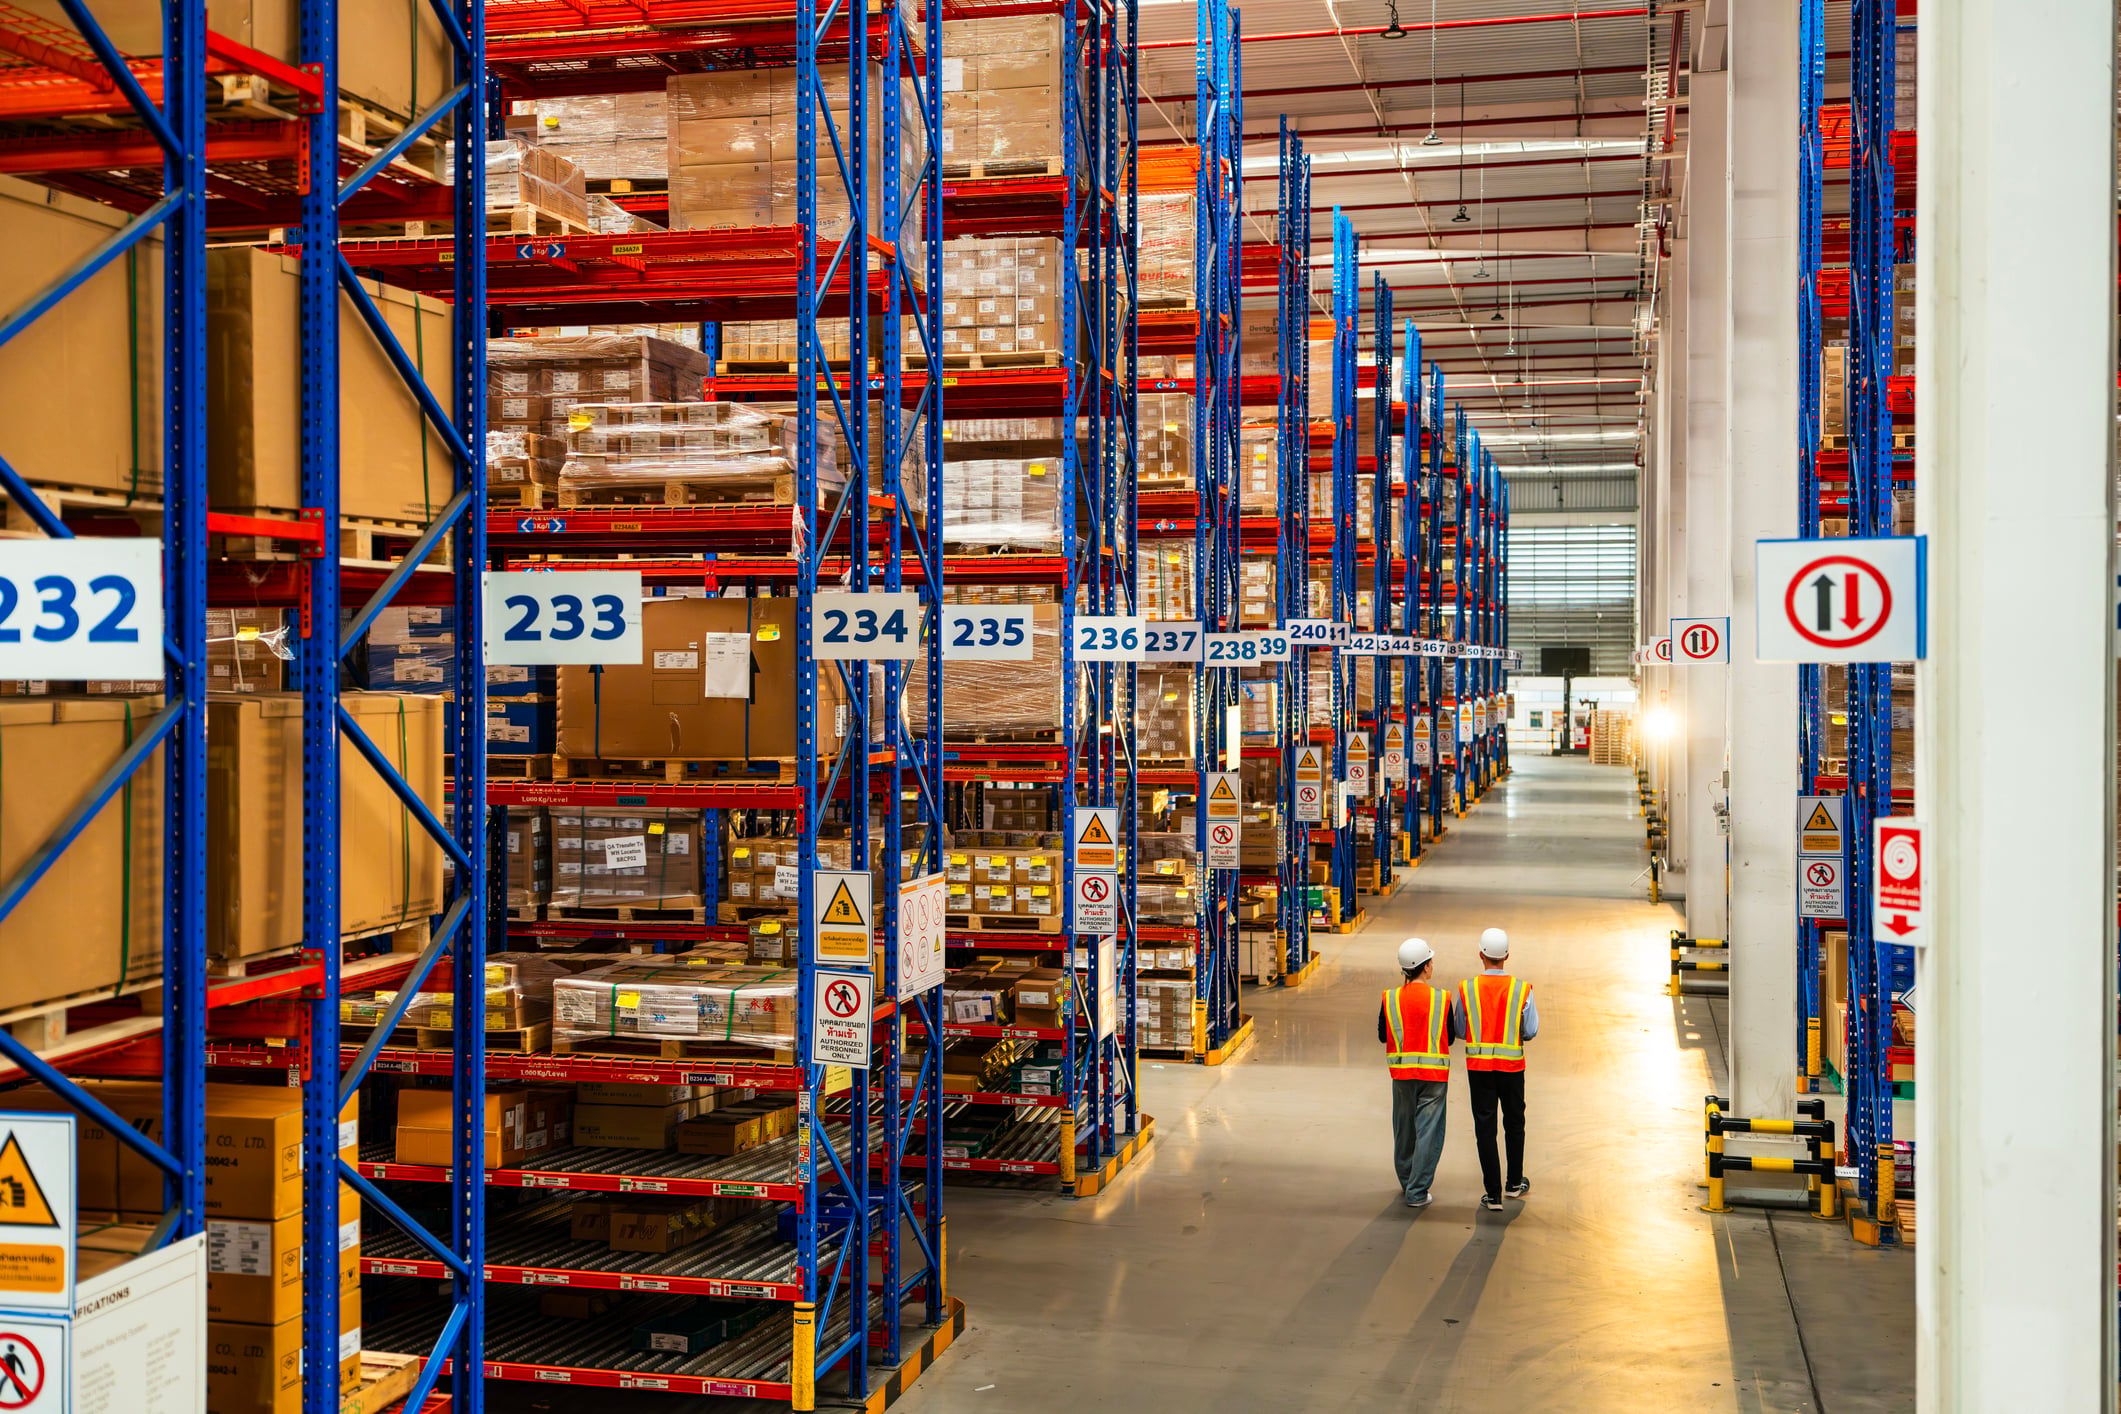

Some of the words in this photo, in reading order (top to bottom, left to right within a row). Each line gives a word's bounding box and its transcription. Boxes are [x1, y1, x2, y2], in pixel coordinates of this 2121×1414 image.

[504, 594, 627, 642] 233
[822, 609, 908, 644] 234
[952, 618, 1025, 647] 235
[1080, 628, 1138, 650] 236
[1290, 624, 1327, 639] 240
[1330, 627, 1345, 640] 41
[1145, 632, 1197, 652] 237
[1209, 640, 1256, 660] 238
[1260, 638, 1286, 655] 39
[820, 1038, 864, 1048] AUTHORIZED
[820, 1044, 862, 1054] PERSONNEL
[832, 1052, 851, 1060] ONLY
